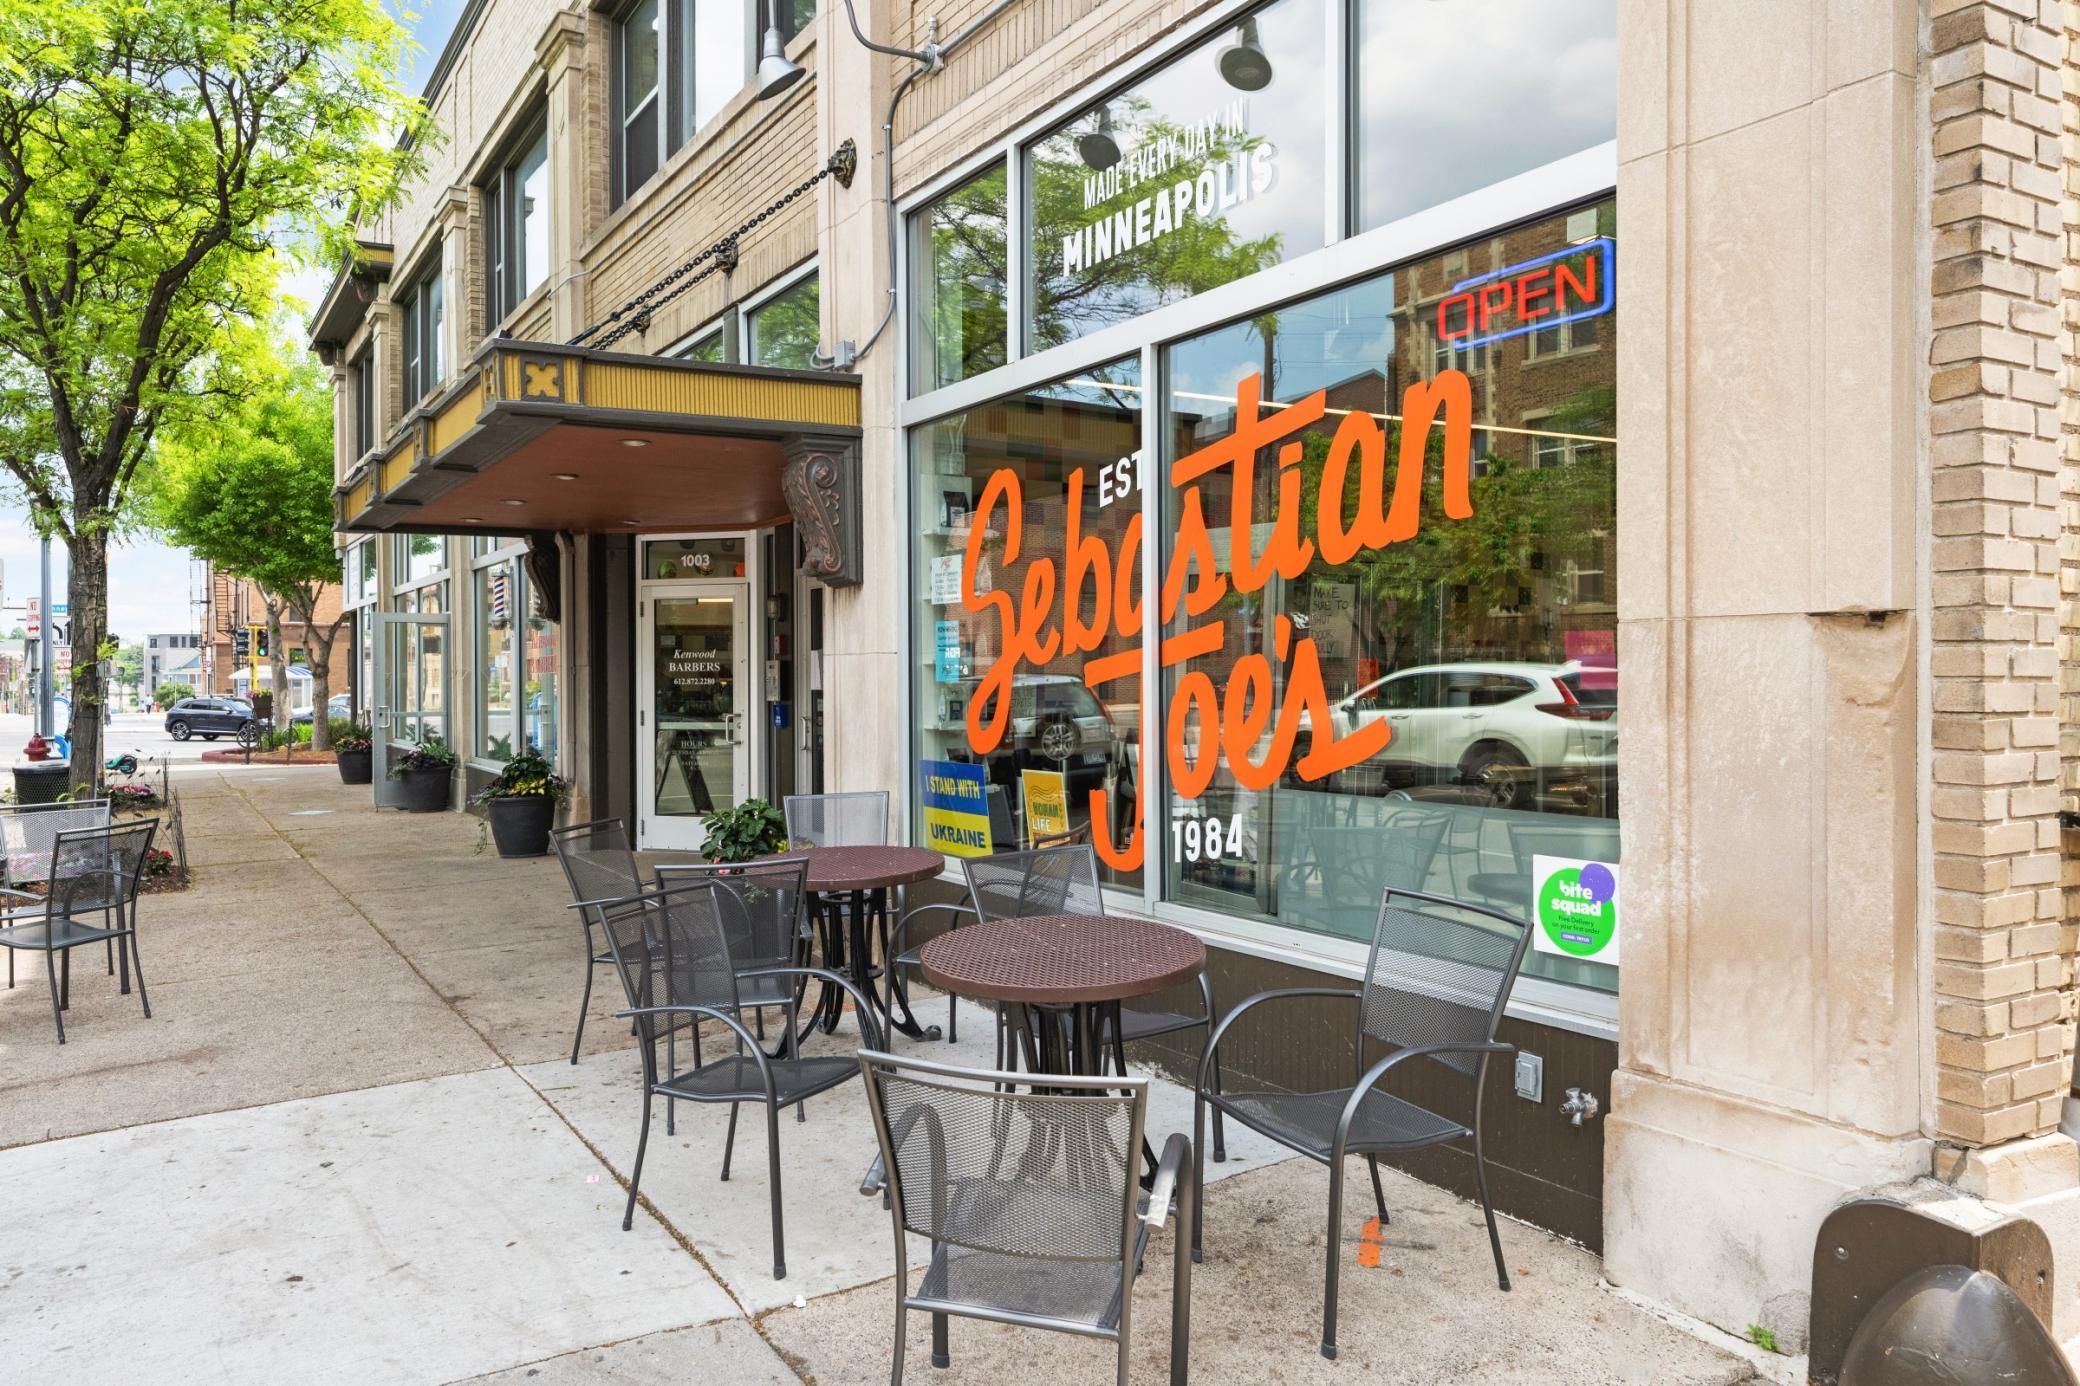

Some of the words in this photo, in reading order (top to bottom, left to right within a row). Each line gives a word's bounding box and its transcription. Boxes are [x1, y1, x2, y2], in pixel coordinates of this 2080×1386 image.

[1084, 161, 1122, 210] MADE
[1129, 132, 1177, 189] EVERY
[1184, 110, 1218, 160] DAY
[1226, 97, 1246, 140] IN
[1063, 142, 1273, 277] MINNEAPOLIS
[1437, 255, 1597, 341] OPEN
[681, 554, 711, 568] 1003
[961, 369, 1474, 755] Sebastian
[1336, 600, 1349, 610] TO
[673, 648, 717, 660] Kenwood
[669, 662, 721, 672] BARBERS
[681, 740, 708, 749] HOURS
[1084, 614, 1392, 872] Joe's
[925, 775, 930, 793] I
[930, 776, 956, 797] STAND
[957, 779, 981, 800] WITH
[1031, 817, 1052, 832] LIFE
[930, 822, 987, 849] UKRAINE
[1172, 813, 1243, 863] 1984
[1559, 880, 1593, 900] bite
[1551, 898, 1602, 917] squad
[1559, 915, 1571, 923] Free
[1572, 917, 1595, 928] Delivery
[1560, 923, 1573, 932] your
[1585, 926, 1600, 935] order
